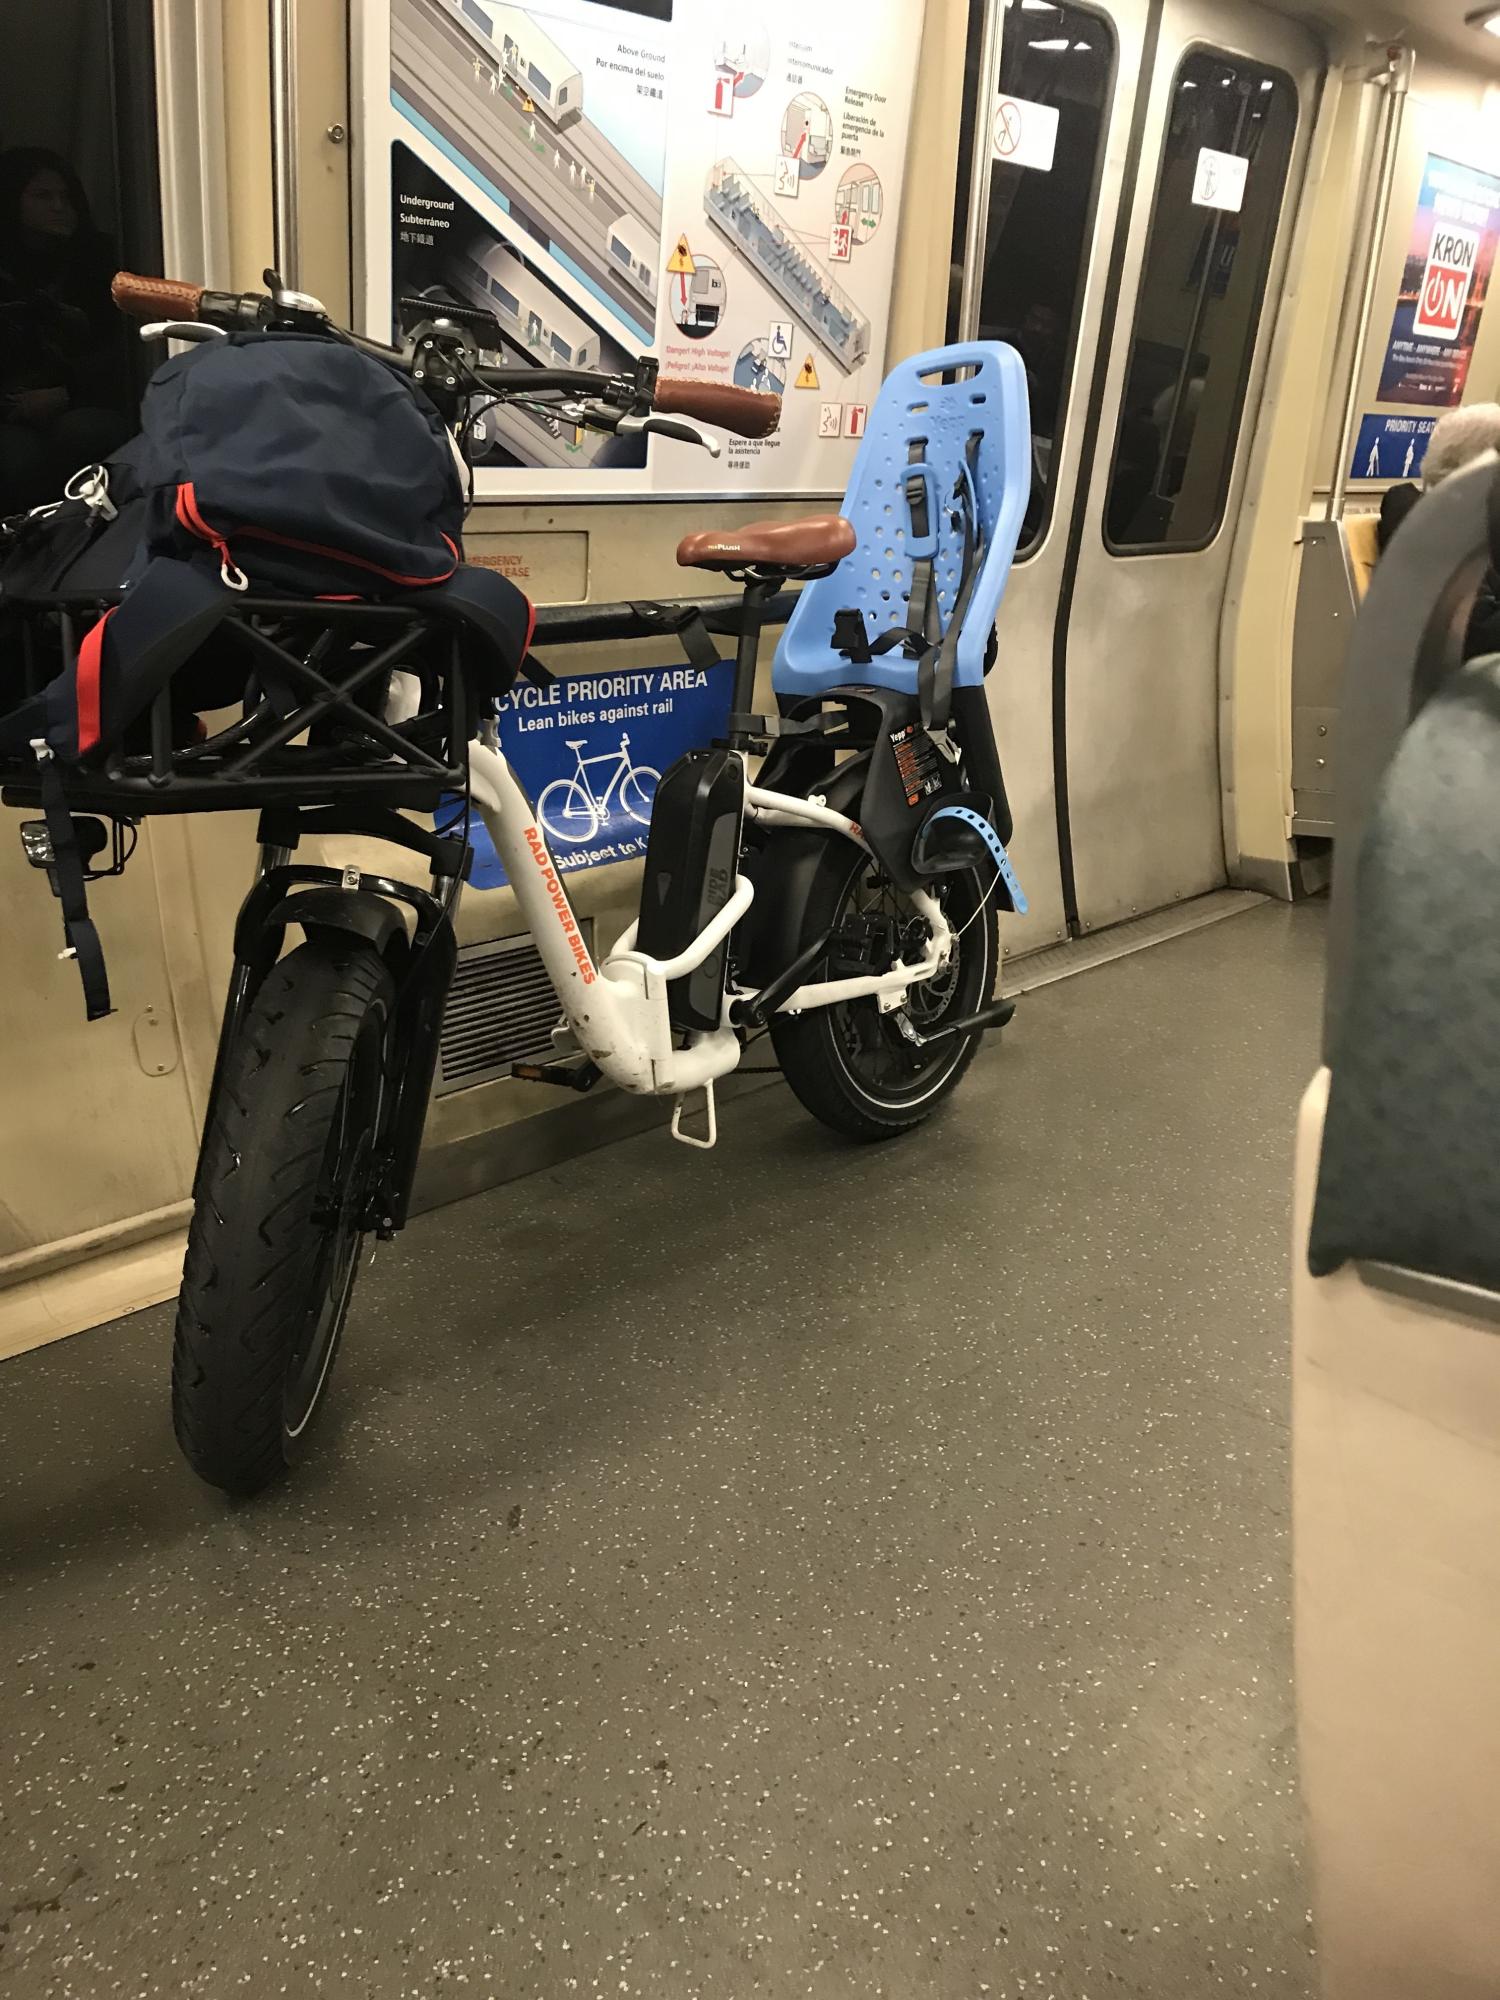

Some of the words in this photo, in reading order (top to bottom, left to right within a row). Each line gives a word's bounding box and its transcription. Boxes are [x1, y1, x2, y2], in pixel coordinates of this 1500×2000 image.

[617, 44, 639, 56] Above
[641, 49, 666, 63] Ground
[596, 57, 608, 67] Por
[610, 62, 633, 74] encima
[635, 67, 646, 76] del
[647, 71, 664, 80] suelo
[844, 96, 864, 107] Release
[845, 86, 873, 102] Emergency
[874, 93, 887, 103] Door
[843, 112, 868, 124] Liberación
[870, 118, 876, 126] de
[841, 132, 859, 141] puerta
[842, 122, 871, 135] emergencia
[872, 128, 878, 136] de
[880, 129, 885, 137] la
[400, 194, 455, 210] Underground
[400, 213, 450, 228] Subterráneo
[1432, 233, 1475, 268] KRON
[1424, 270, 1465, 320] ON
[1384, 419, 1417, 432] PRIORITY
[729, 438, 747, 447] Espere
[764, 439, 781, 448] llegue
[467, 555, 523, 566] MERGENCY
[495, 567, 530, 577] LEASE
[492, 684, 561, 712] CYCLE
[567, 674, 654, 703] PRIORITY
[659, 669, 708, 692] AREA
[518, 716, 554, 732] Lean
[558, 709, 596, 727] bikes
[599, 702, 649, 723] against
[652, 698, 673, 715] rail
[889, 728, 906, 742] Yepp
[553, 845, 618, 869] Subject
[618, 843, 637, 855] to
[523, 827, 548, 866] RAD
[541, 868, 576, 934] POWER
[568, 934, 596, 985] BIKES
